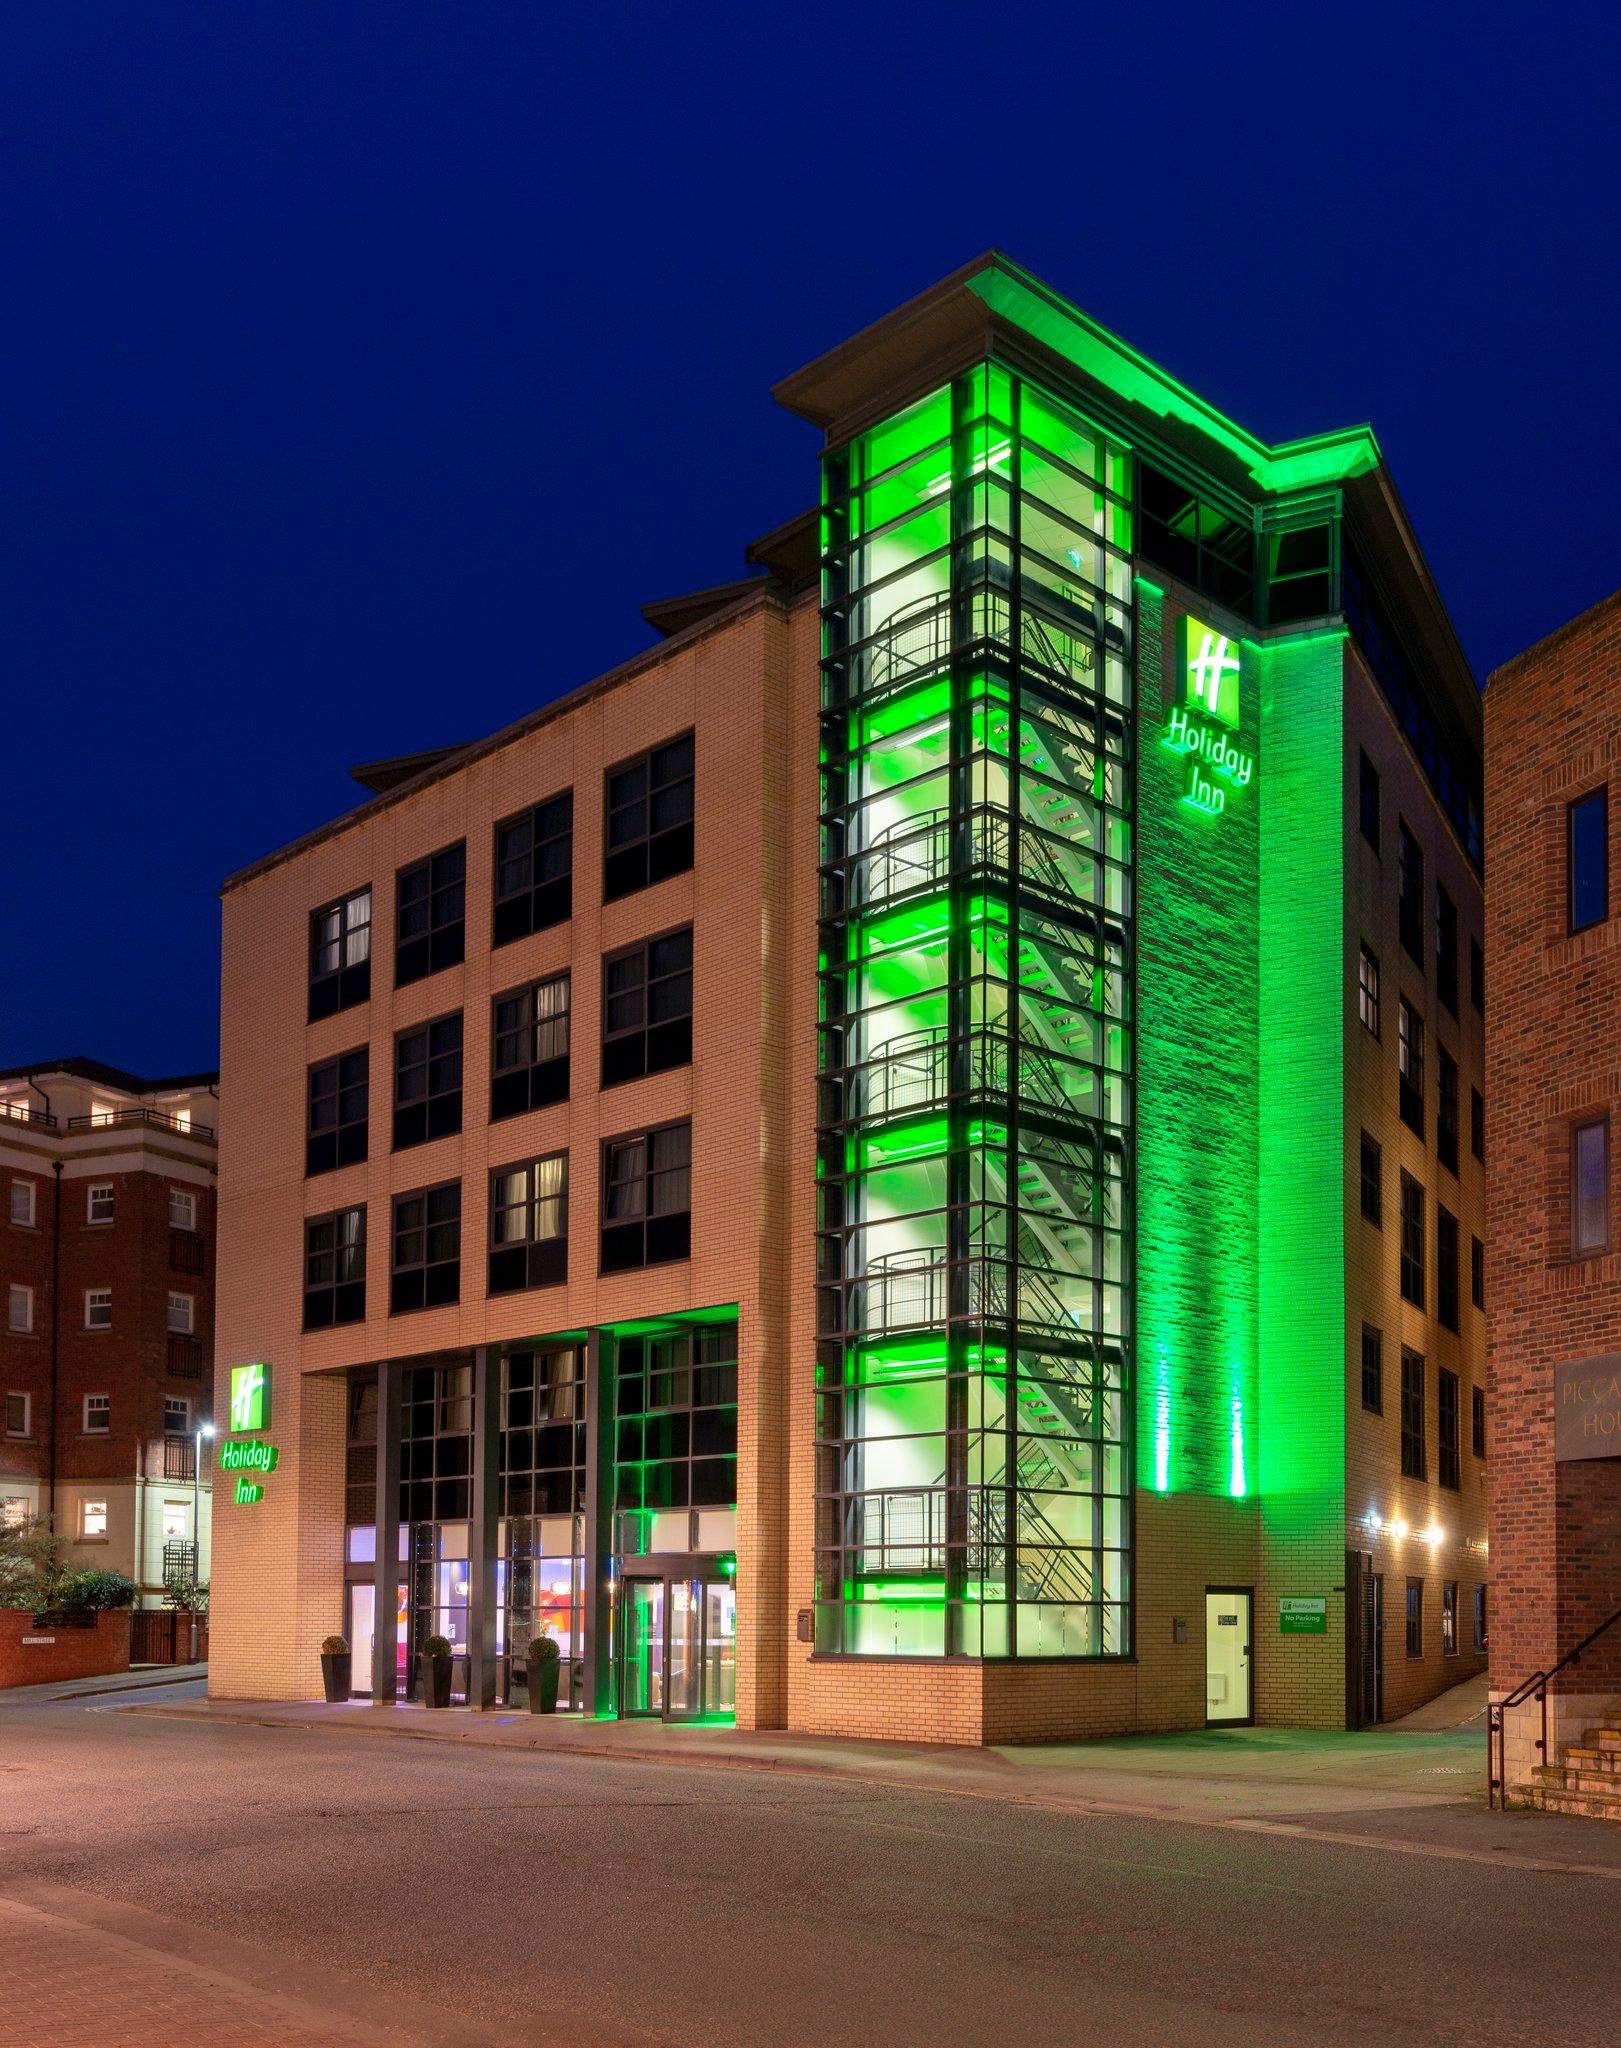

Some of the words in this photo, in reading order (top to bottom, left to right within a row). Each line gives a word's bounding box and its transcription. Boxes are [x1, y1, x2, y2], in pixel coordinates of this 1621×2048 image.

[1170, 707, 1253, 785] Holiday
[1191, 765, 1225, 811] Inn
[221, 1440, 272, 1471] Holiday
[235, 1477, 257, 1504] Inn
[1292, 1601, 1310, 1609] Holiday
[1295, 1614, 1321, 1623] Parking
